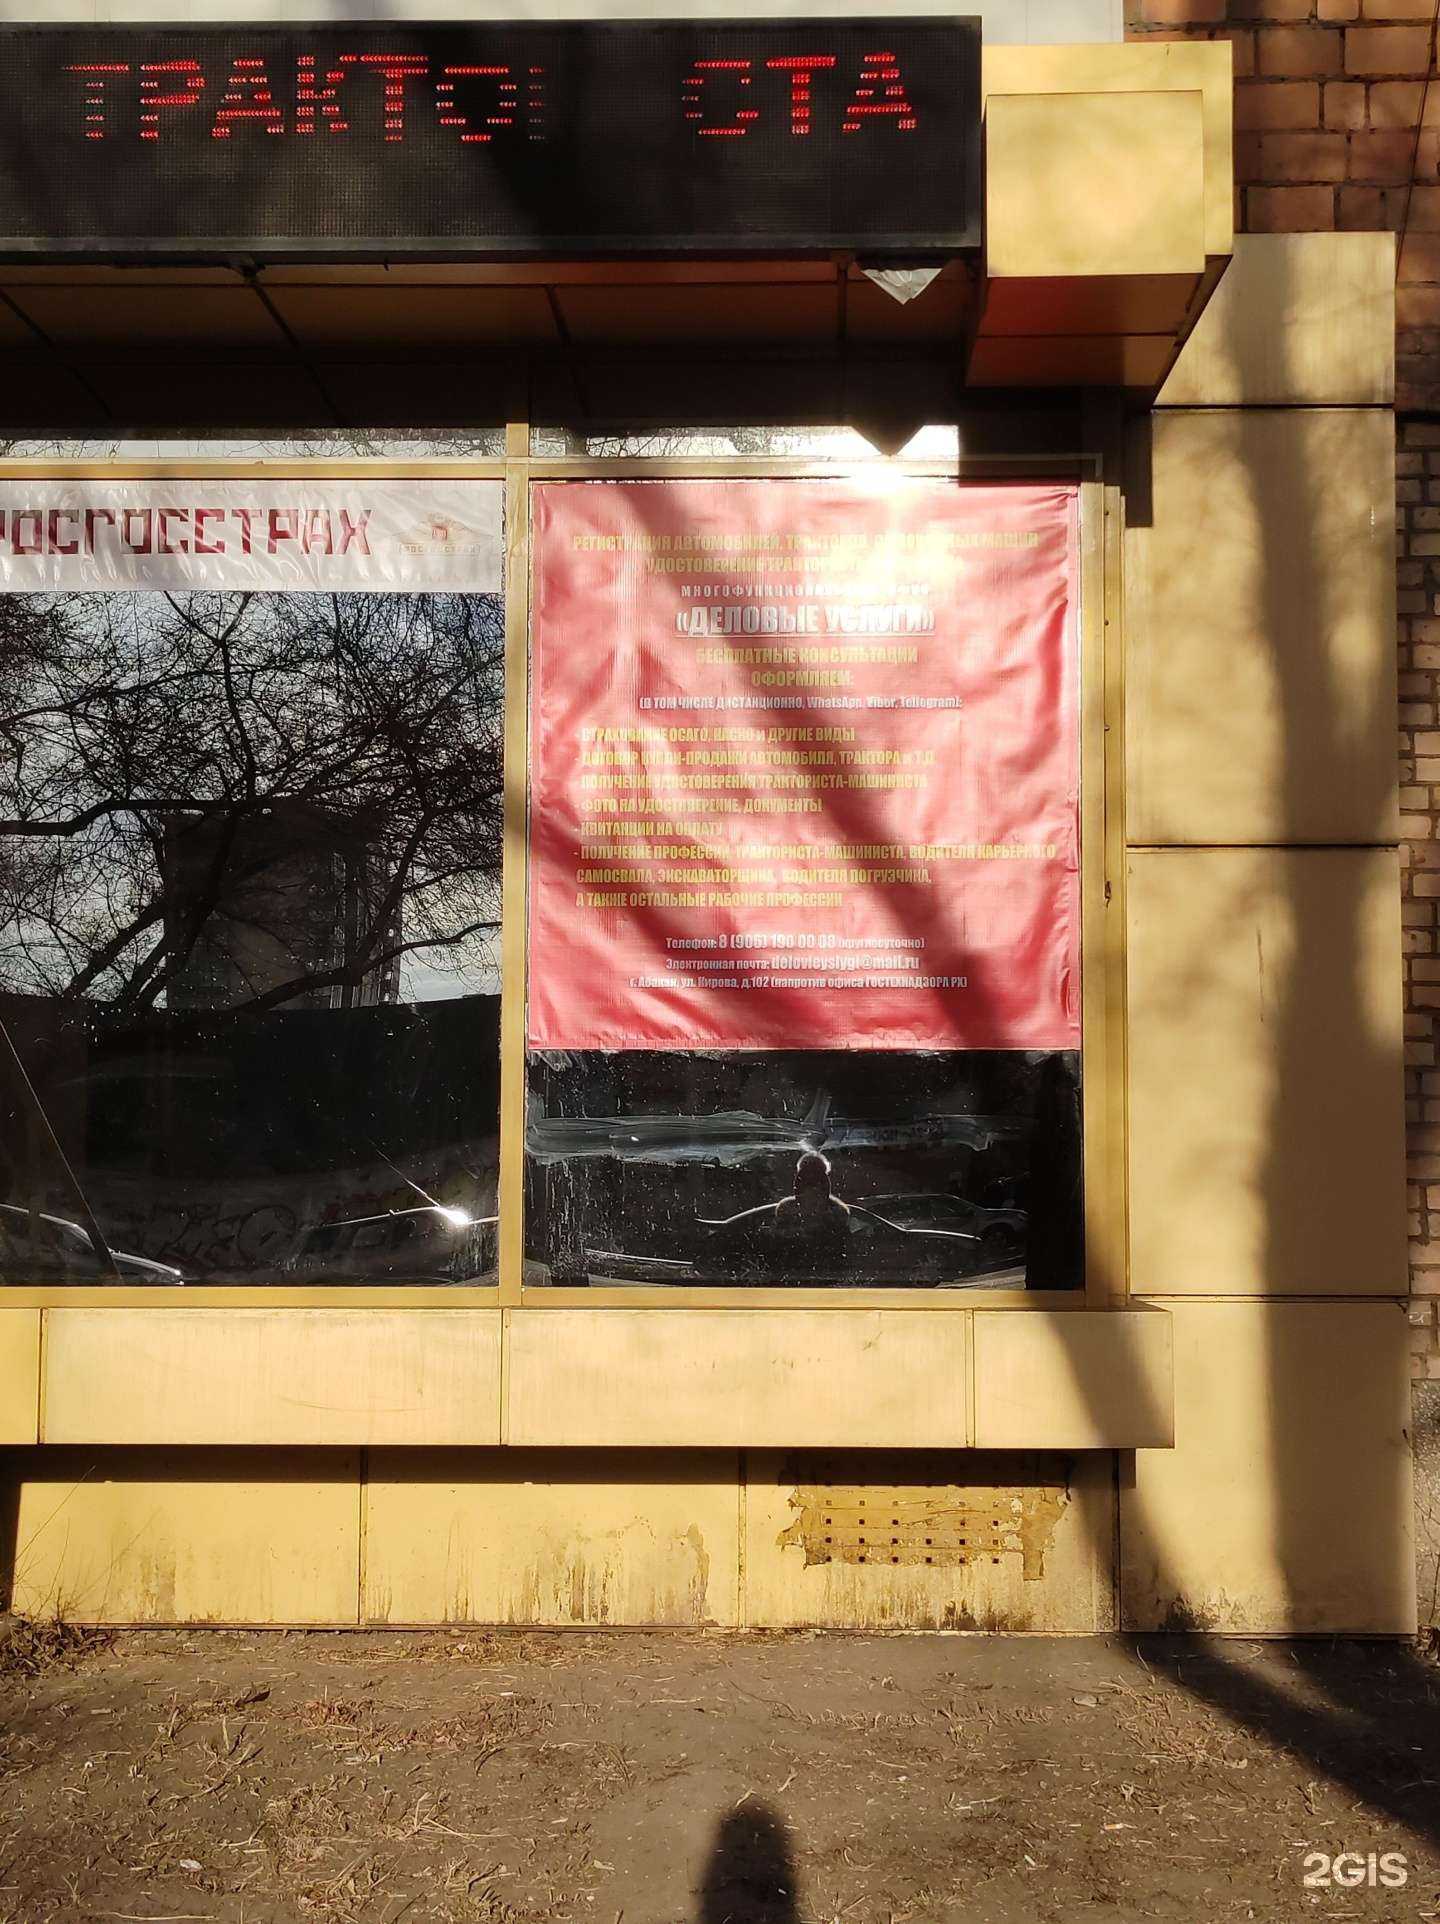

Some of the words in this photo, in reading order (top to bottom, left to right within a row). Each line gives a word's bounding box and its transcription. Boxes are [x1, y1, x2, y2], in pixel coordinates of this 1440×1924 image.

[0, 508, 373, 555] ОСГОССТРАХ
[675, 604, 819, 636] «ДЕЛОВЫЕ
[695, 646, 798, 665] БЕСПЛАТНЫЕ
[654, 697, 676, 710] ТОМ
[678, 697, 715, 710] ЧИСЛЕ
[716, 697, 805, 710] ДИСТАНЦИОННО,
[767, 727, 814, 742] ДРУГИЕ
[815, 727, 855, 742] ВИДЫ
[656, 821, 673, 837] НА
[580, 844, 652, 860] ПОЛУЧЕНИЕ
[576, 892, 585, 907] А
[587, 892, 628, 907] ТАКЖЕ
[629, 892, 706, 907] ОСТАЛЬНЫЕ
[707, 892, 768, 907] РАБОЧИЕ
[666, 938, 717, 950] Телефон:
[718, 934, 728, 949] 8
[666, 958, 735, 971] Электронная
[736, 958, 770, 971] почта:
[828, 976, 864, 989] офиса
